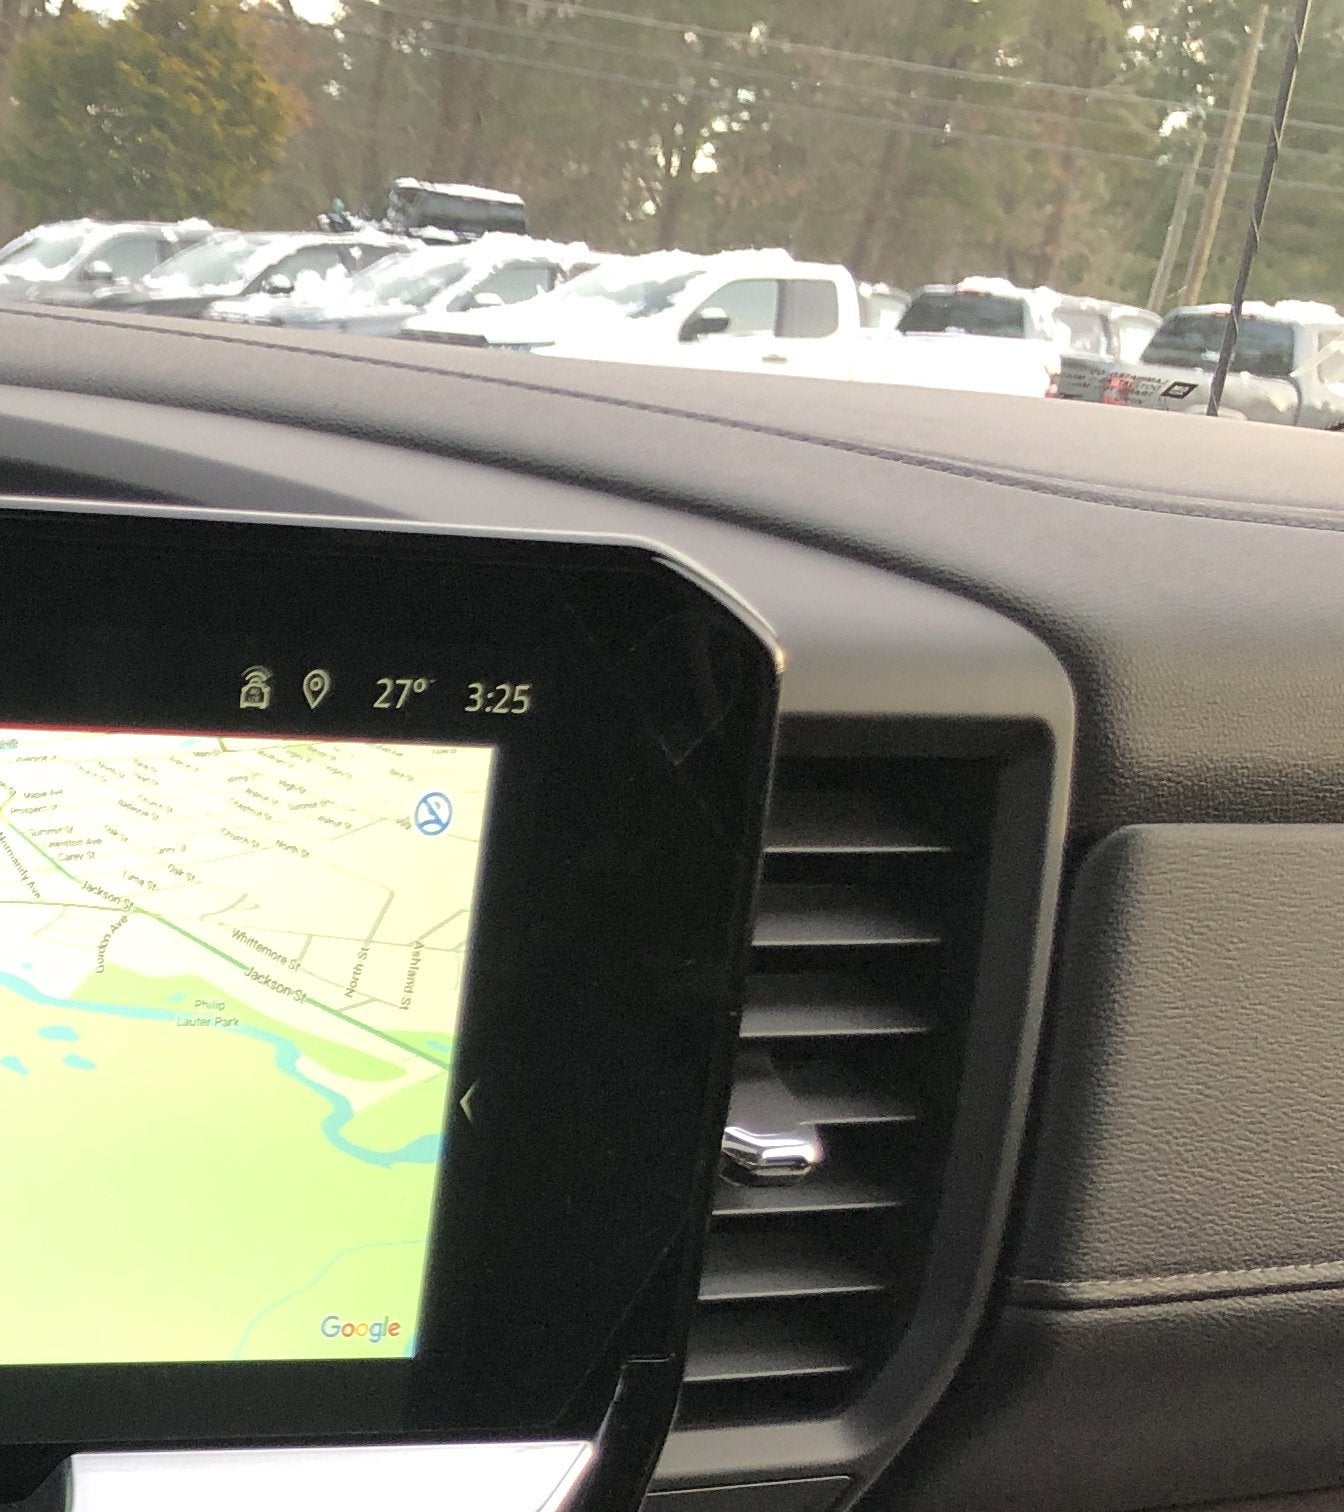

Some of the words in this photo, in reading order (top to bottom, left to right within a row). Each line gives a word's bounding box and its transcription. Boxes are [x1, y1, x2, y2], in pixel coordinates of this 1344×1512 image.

[464, 682, 532, 714] 3:25
[27, 881, 41, 899] Ave
[82, 881, 121, 905] Jackson
[122, 898, 134, 912] St
[110, 915, 129, 934] Ave
[231, 927, 288, 965] Whittemore
[288, 958, 301, 972] St
[344, 963, 364, 998] North
[357, 947, 370, 961] St
[403, 940, 425, 994] Ashland
[244, 967, 292, 996] Jackson
[293, 988, 307, 1004] St
[399, 996, 412, 1010] St
[177, 1016, 211, 1027] Lauter
[214, 1016, 240, 1027] Park
[320, 1315, 401, 1343] Google
